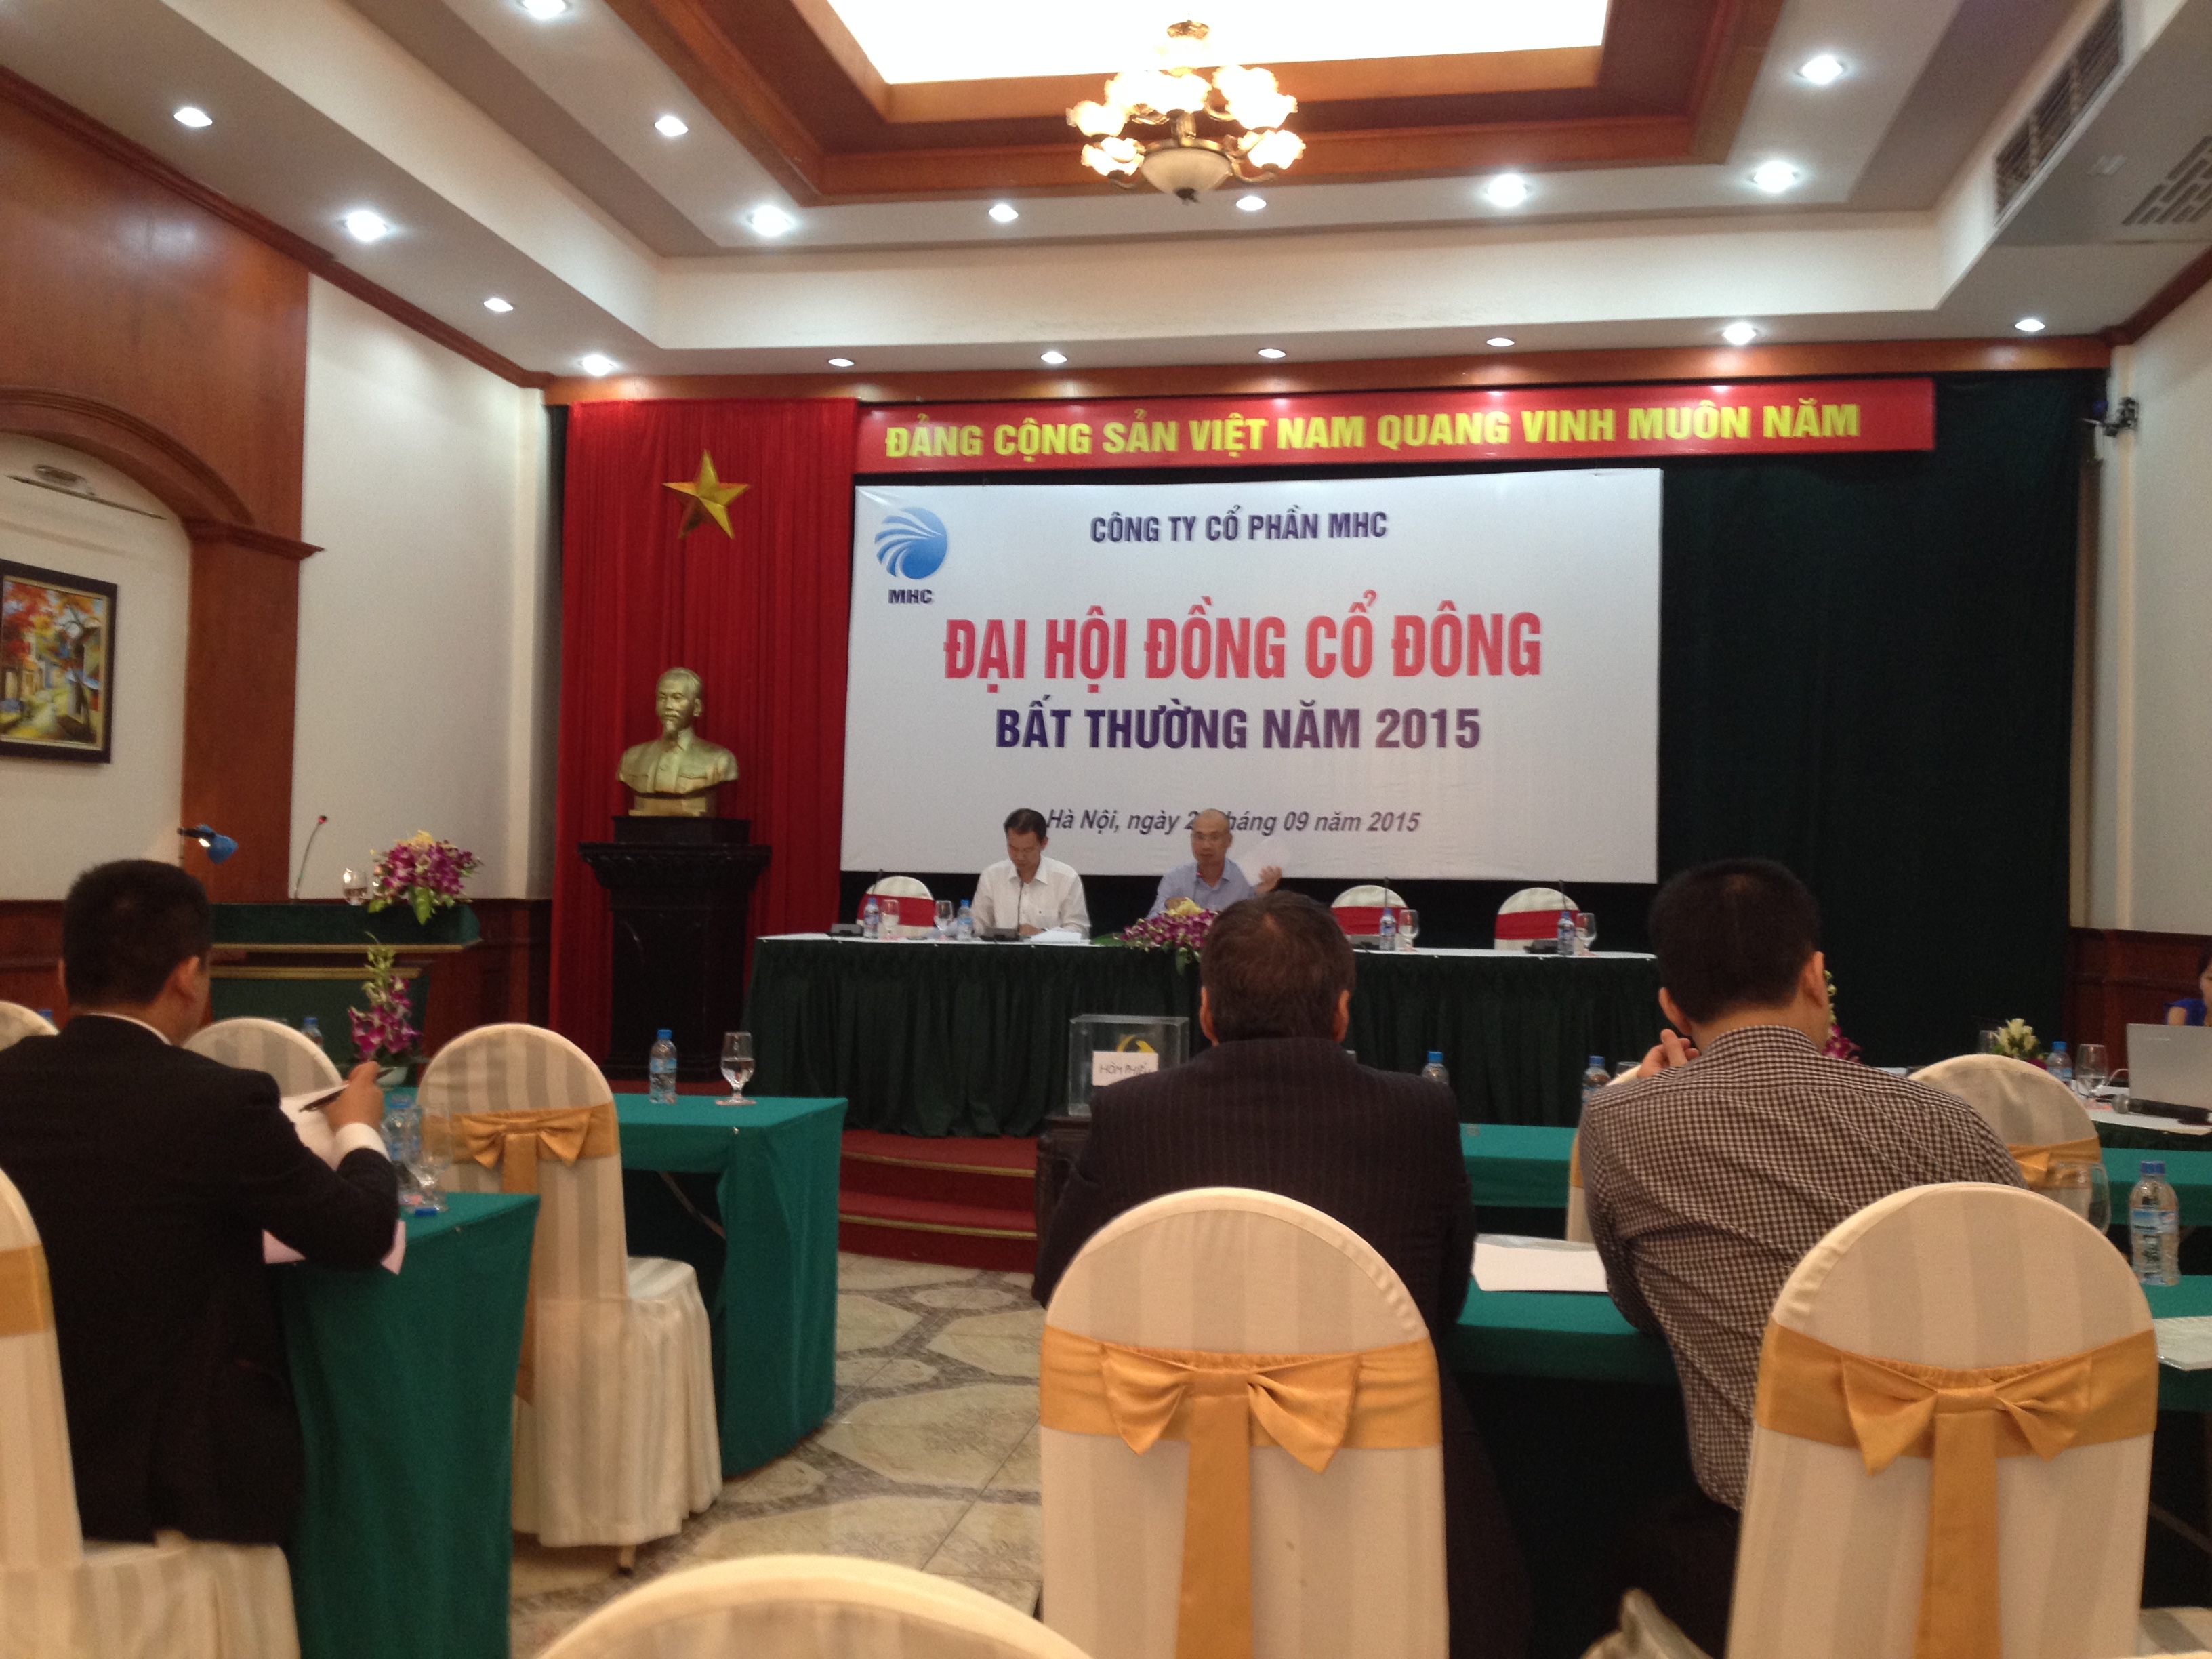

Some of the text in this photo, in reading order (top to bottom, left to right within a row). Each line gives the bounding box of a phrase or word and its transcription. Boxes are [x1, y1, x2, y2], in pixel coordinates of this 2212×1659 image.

[886, 394, 1859, 462] ĐẢNG CỘNG SẢN VIỆT NAM QUANG VINH MUÔN NĂM
[1090, 505, 1388, 543] CÔNG TY CỔ PHẦN MHC
[888, 589, 933, 604] MHC
[944, 590, 1541, 693] ĐẠI HỘI ĐỒNG CỔ ĐÔNG
[996, 694, 1480, 749] BẤT THƯỜNG NĂM 2015
[1046, 809, 1073, 829] Hà
[1080, 810, 1119, 834] Nội,
[1127, 810, 1180, 835] ngày
[1225, 810, 1277, 836] háng
[1284, 811, 1309, 831] 09
[1315, 811, 1361, 831] năm
[1367, 812, 1420, 832] 2015
